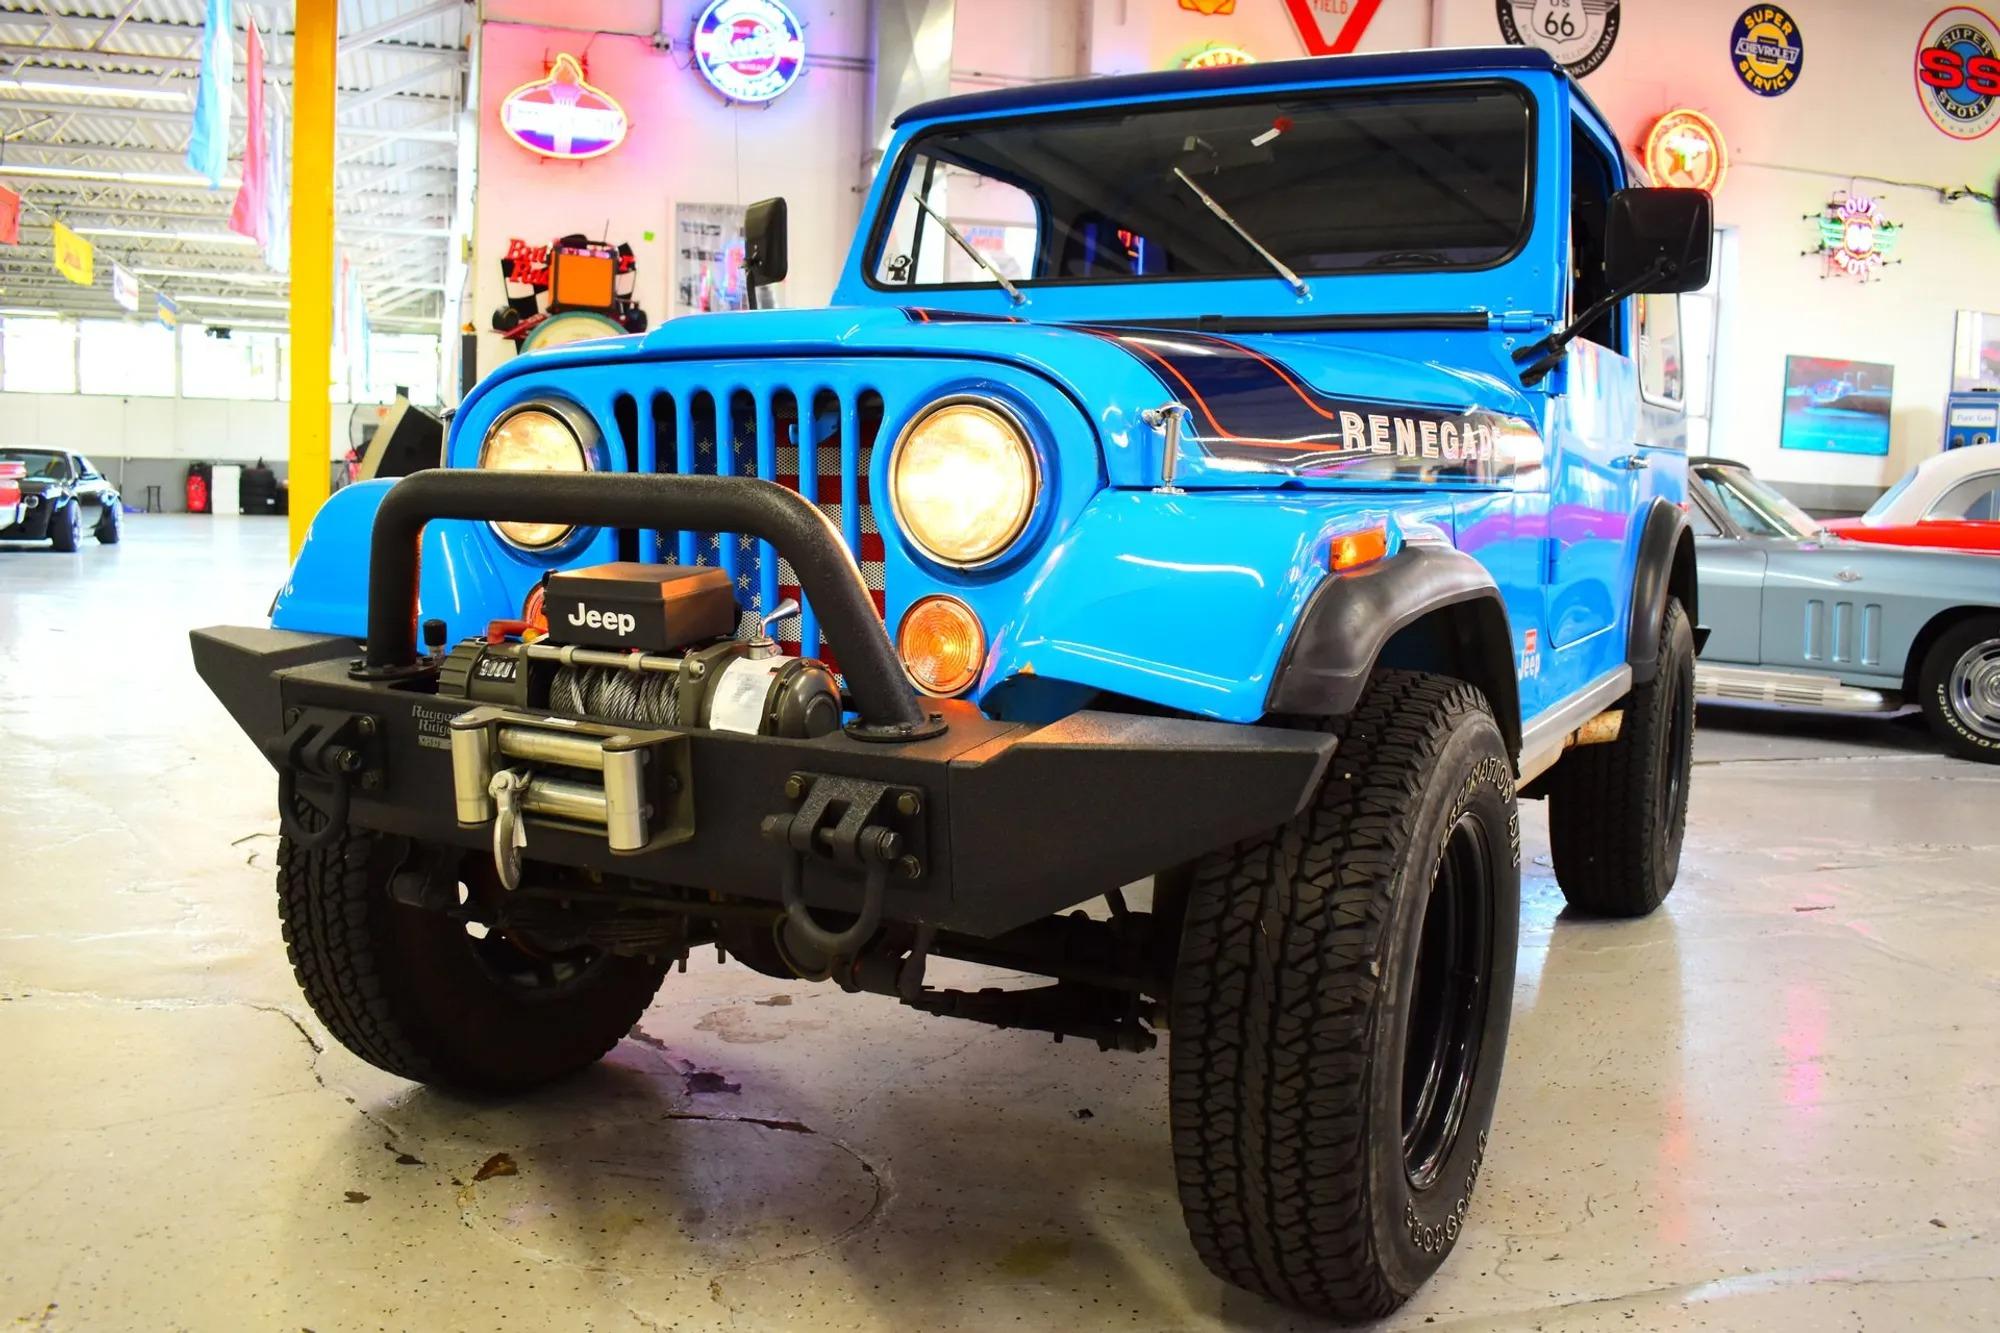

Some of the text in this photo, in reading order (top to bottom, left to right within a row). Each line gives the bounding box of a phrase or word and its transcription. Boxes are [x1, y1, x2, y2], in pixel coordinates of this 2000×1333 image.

[1312, 0, 1348, 15] YIELD
[1544, 11, 1575, 37] 66
[1744, 9, 1793, 36] SUPER
[1739, 42, 1796, 60] CHEVROLET
[1942, 28, 1991, 55] SUPER
[1739, 60, 1794, 91] SERVICE
[1919, 46, 2000, 97] SS
[1938, 91, 1988, 118] SPORT
[568, 602, 636, 636] Jeep
[1518, 652, 1541, 681] Jeep
